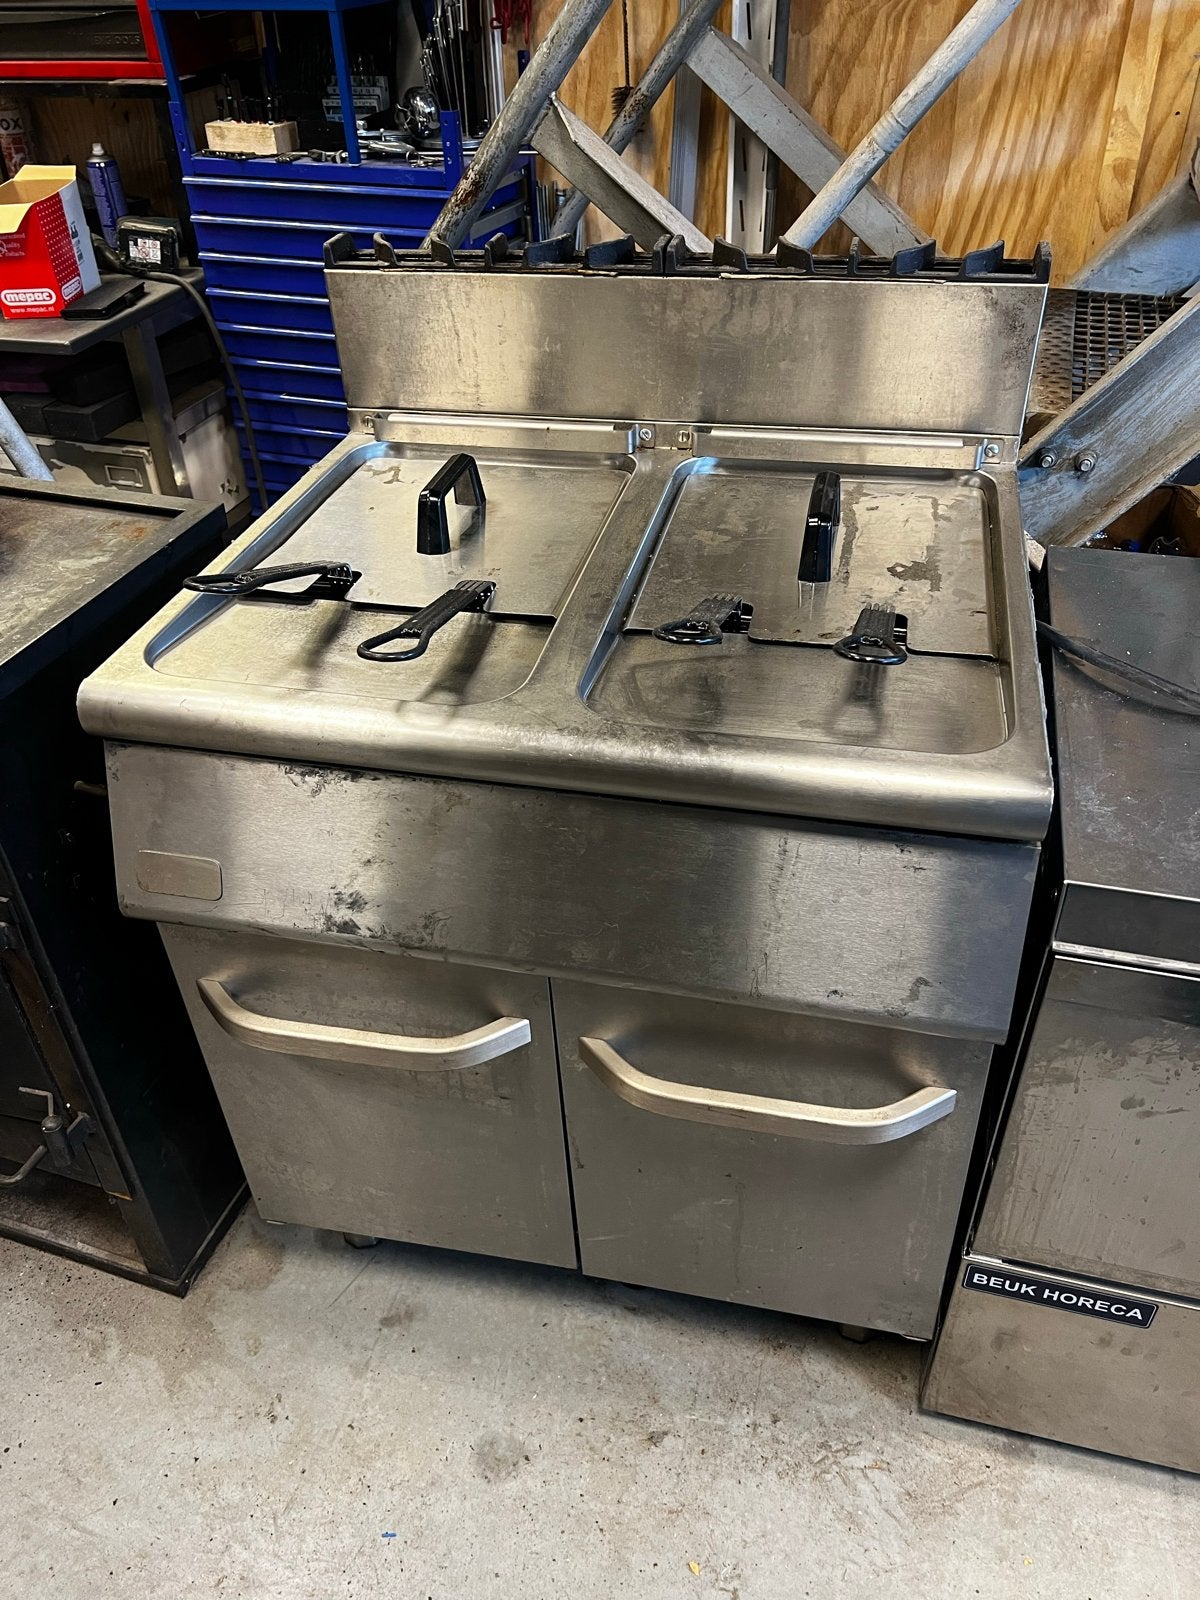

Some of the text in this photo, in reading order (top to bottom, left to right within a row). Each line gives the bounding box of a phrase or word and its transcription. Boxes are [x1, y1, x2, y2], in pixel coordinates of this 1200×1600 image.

[6, 292, 51, 302] mepac
[10, 305, 55, 313] www.mepac.nl
[972, 1273, 1143, 1320] BEUK HORECA
